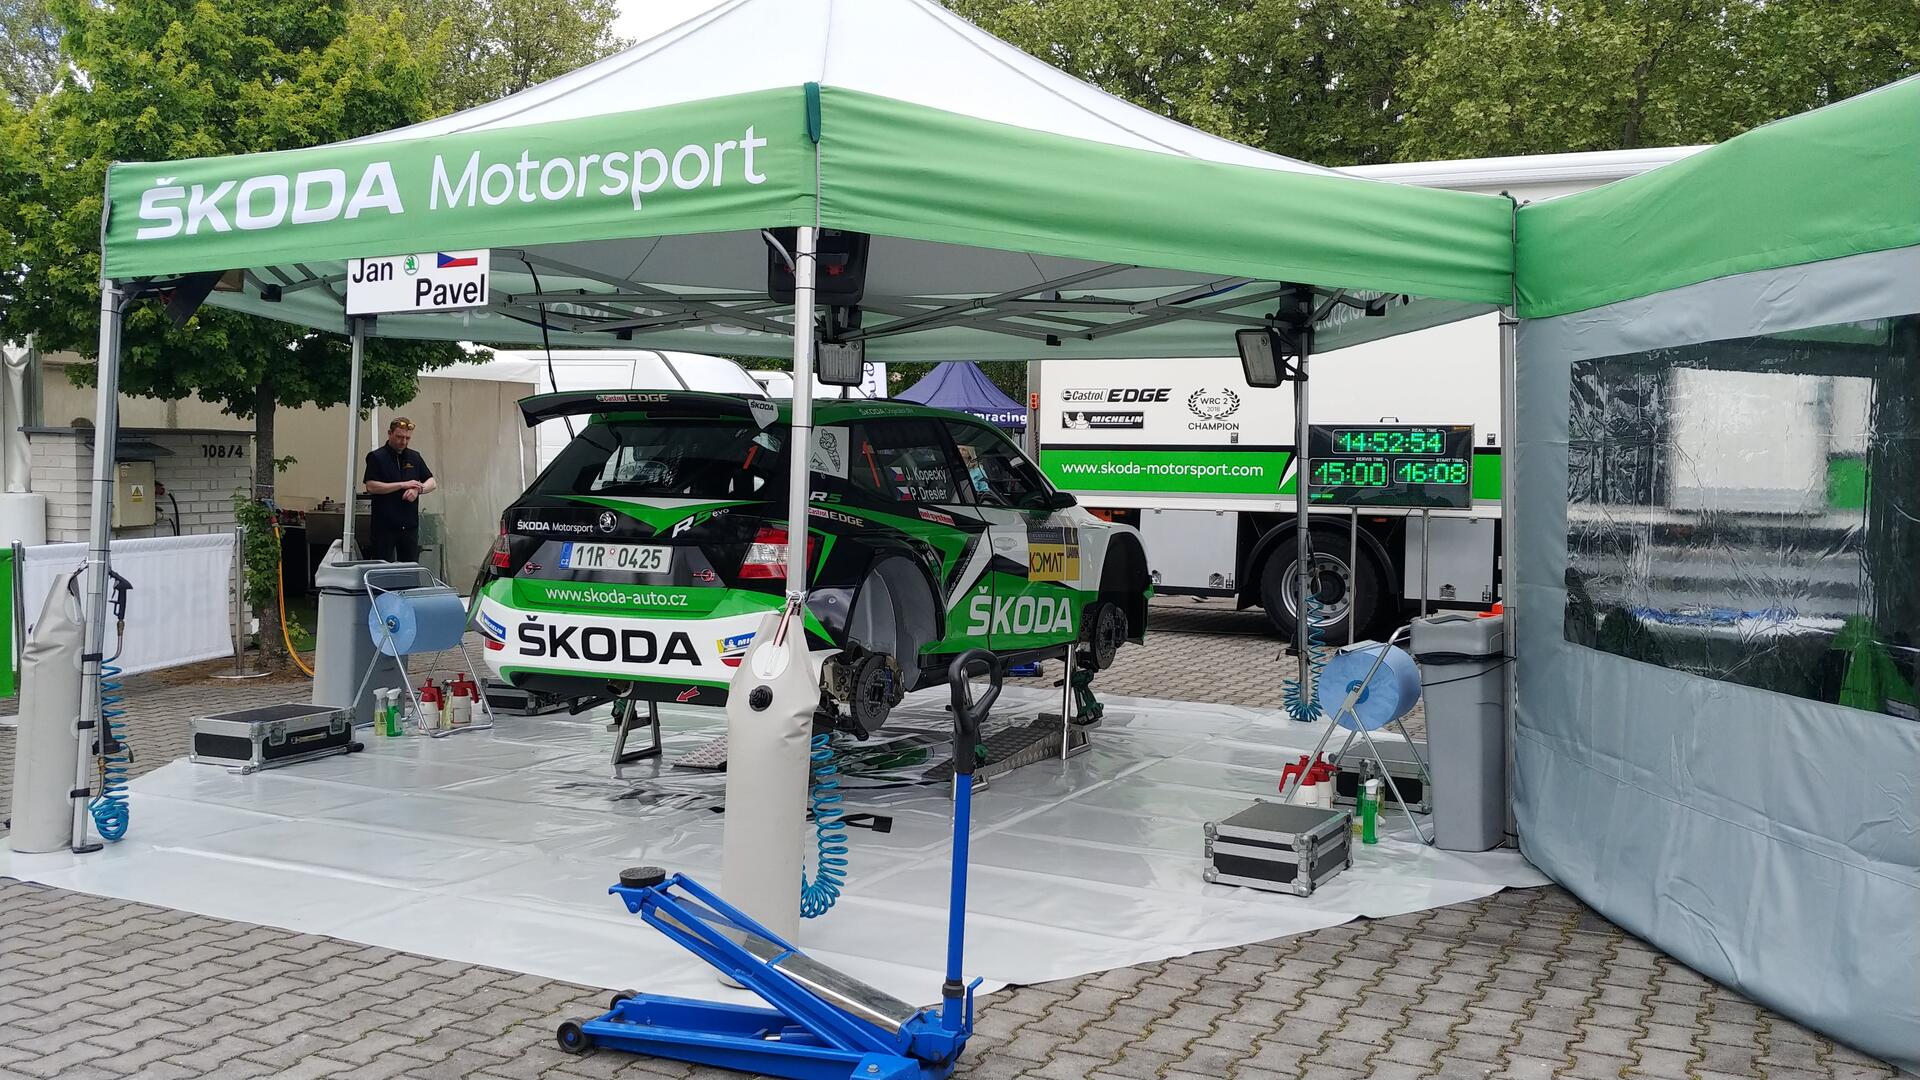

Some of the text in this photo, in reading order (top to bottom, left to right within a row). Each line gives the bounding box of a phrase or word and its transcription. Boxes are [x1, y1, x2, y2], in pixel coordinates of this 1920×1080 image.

[136, 125, 768, 240] ŠKODA Motorsport
[352, 257, 393, 283] Jan
[415, 273, 486, 306] Pavel
[627, 393, 671, 402] EDGE
[1072, 388, 1172, 403] Castrol EDGE
[1200, 397, 1229, 405] WRC 2
[750, 401, 775, 411] ŠKODA
[964, 410, 1027, 425] mracing
[1091, 415, 1144, 424] MICHELIN
[1187, 422, 1240, 431] CHAMPION
[202, 444, 244, 458] 108/4
[1339, 432, 1442, 453] 14:52:54
[914, 466, 947, 483] Kopecký
[1061, 461, 1264, 479] www.skoda-motorsport.com
[1314, 462, 1386, 486] 15:00
[1398, 462, 1466, 483] 16:08
[809, 491, 842, 503] R5
[920, 486, 948, 500] Dresler
[517, 519, 594, 534] ŠKODA Motorsport
[671, 508, 730, 539] R5 evo
[829, 511, 864, 527] EDGE
[576, 545, 606, 567] 11R
[617, 547, 662, 569] 0425
[1028, 551, 1065, 573] KOMAT
[545, 587, 688, 606] www.skoda-auto.cz
[967, 586, 1073, 636] ŠKODA
[518, 614, 703, 666] ŠKODA
